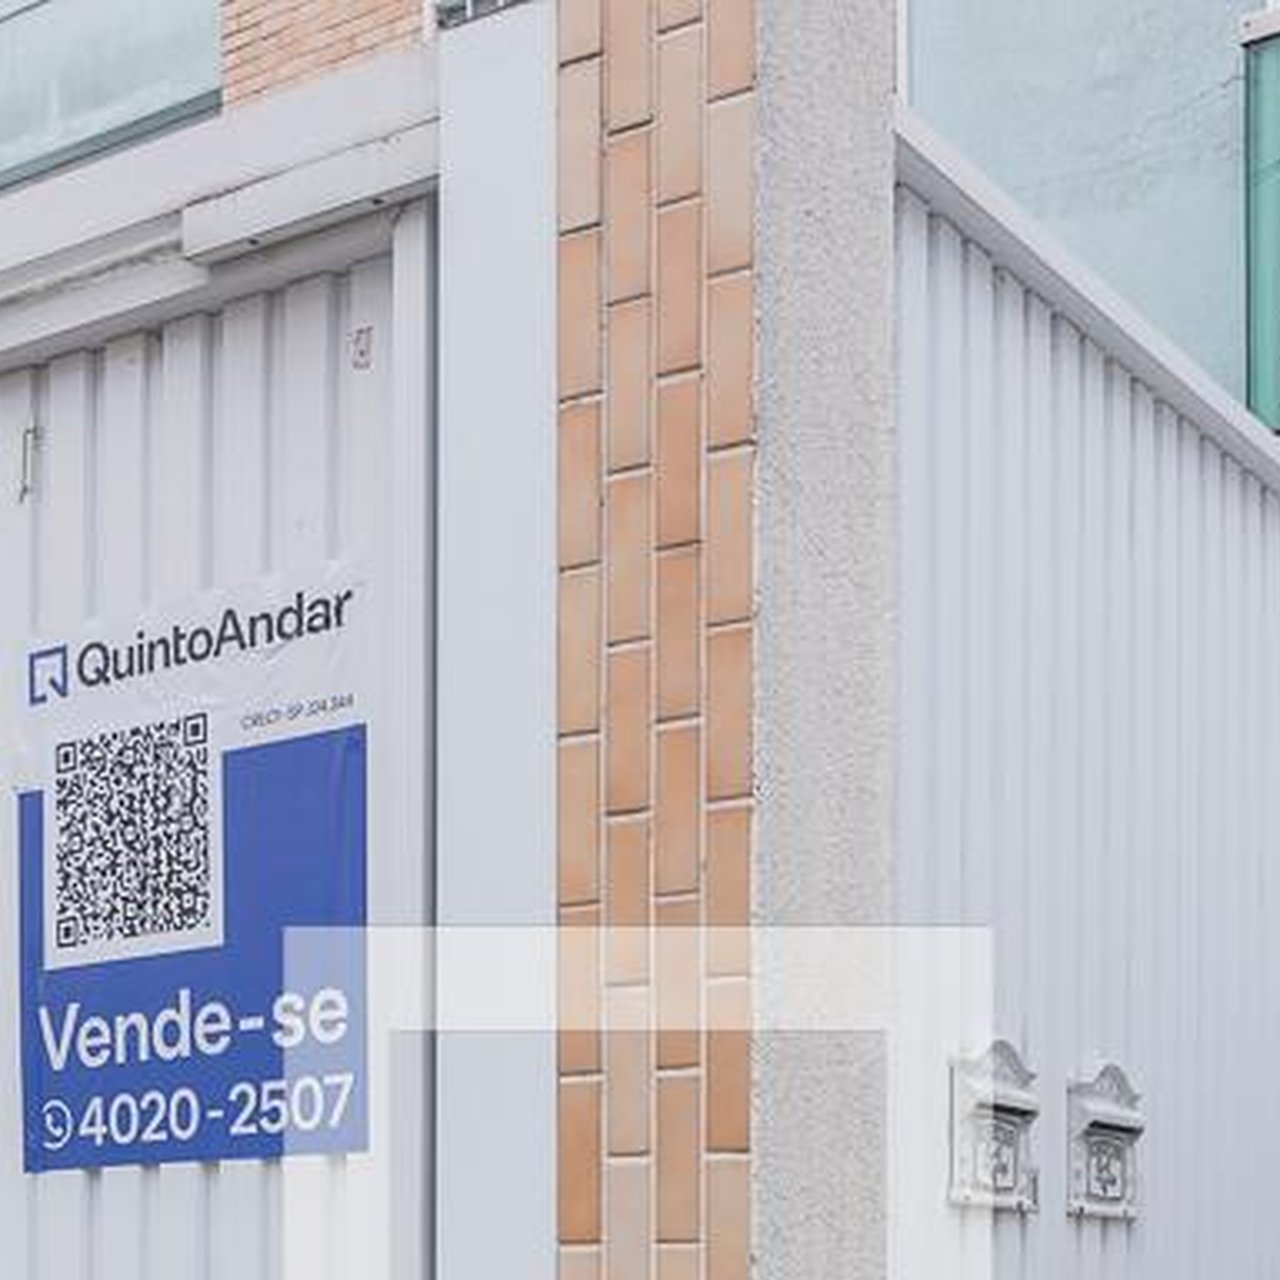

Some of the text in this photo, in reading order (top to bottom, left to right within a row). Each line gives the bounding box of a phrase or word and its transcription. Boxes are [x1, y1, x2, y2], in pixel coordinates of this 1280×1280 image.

[78, 589, 353, 688] QuintoAndar
[39, 987, 349, 1071] Vende-se
[78, 1073, 355, 1146] 4020-2507
